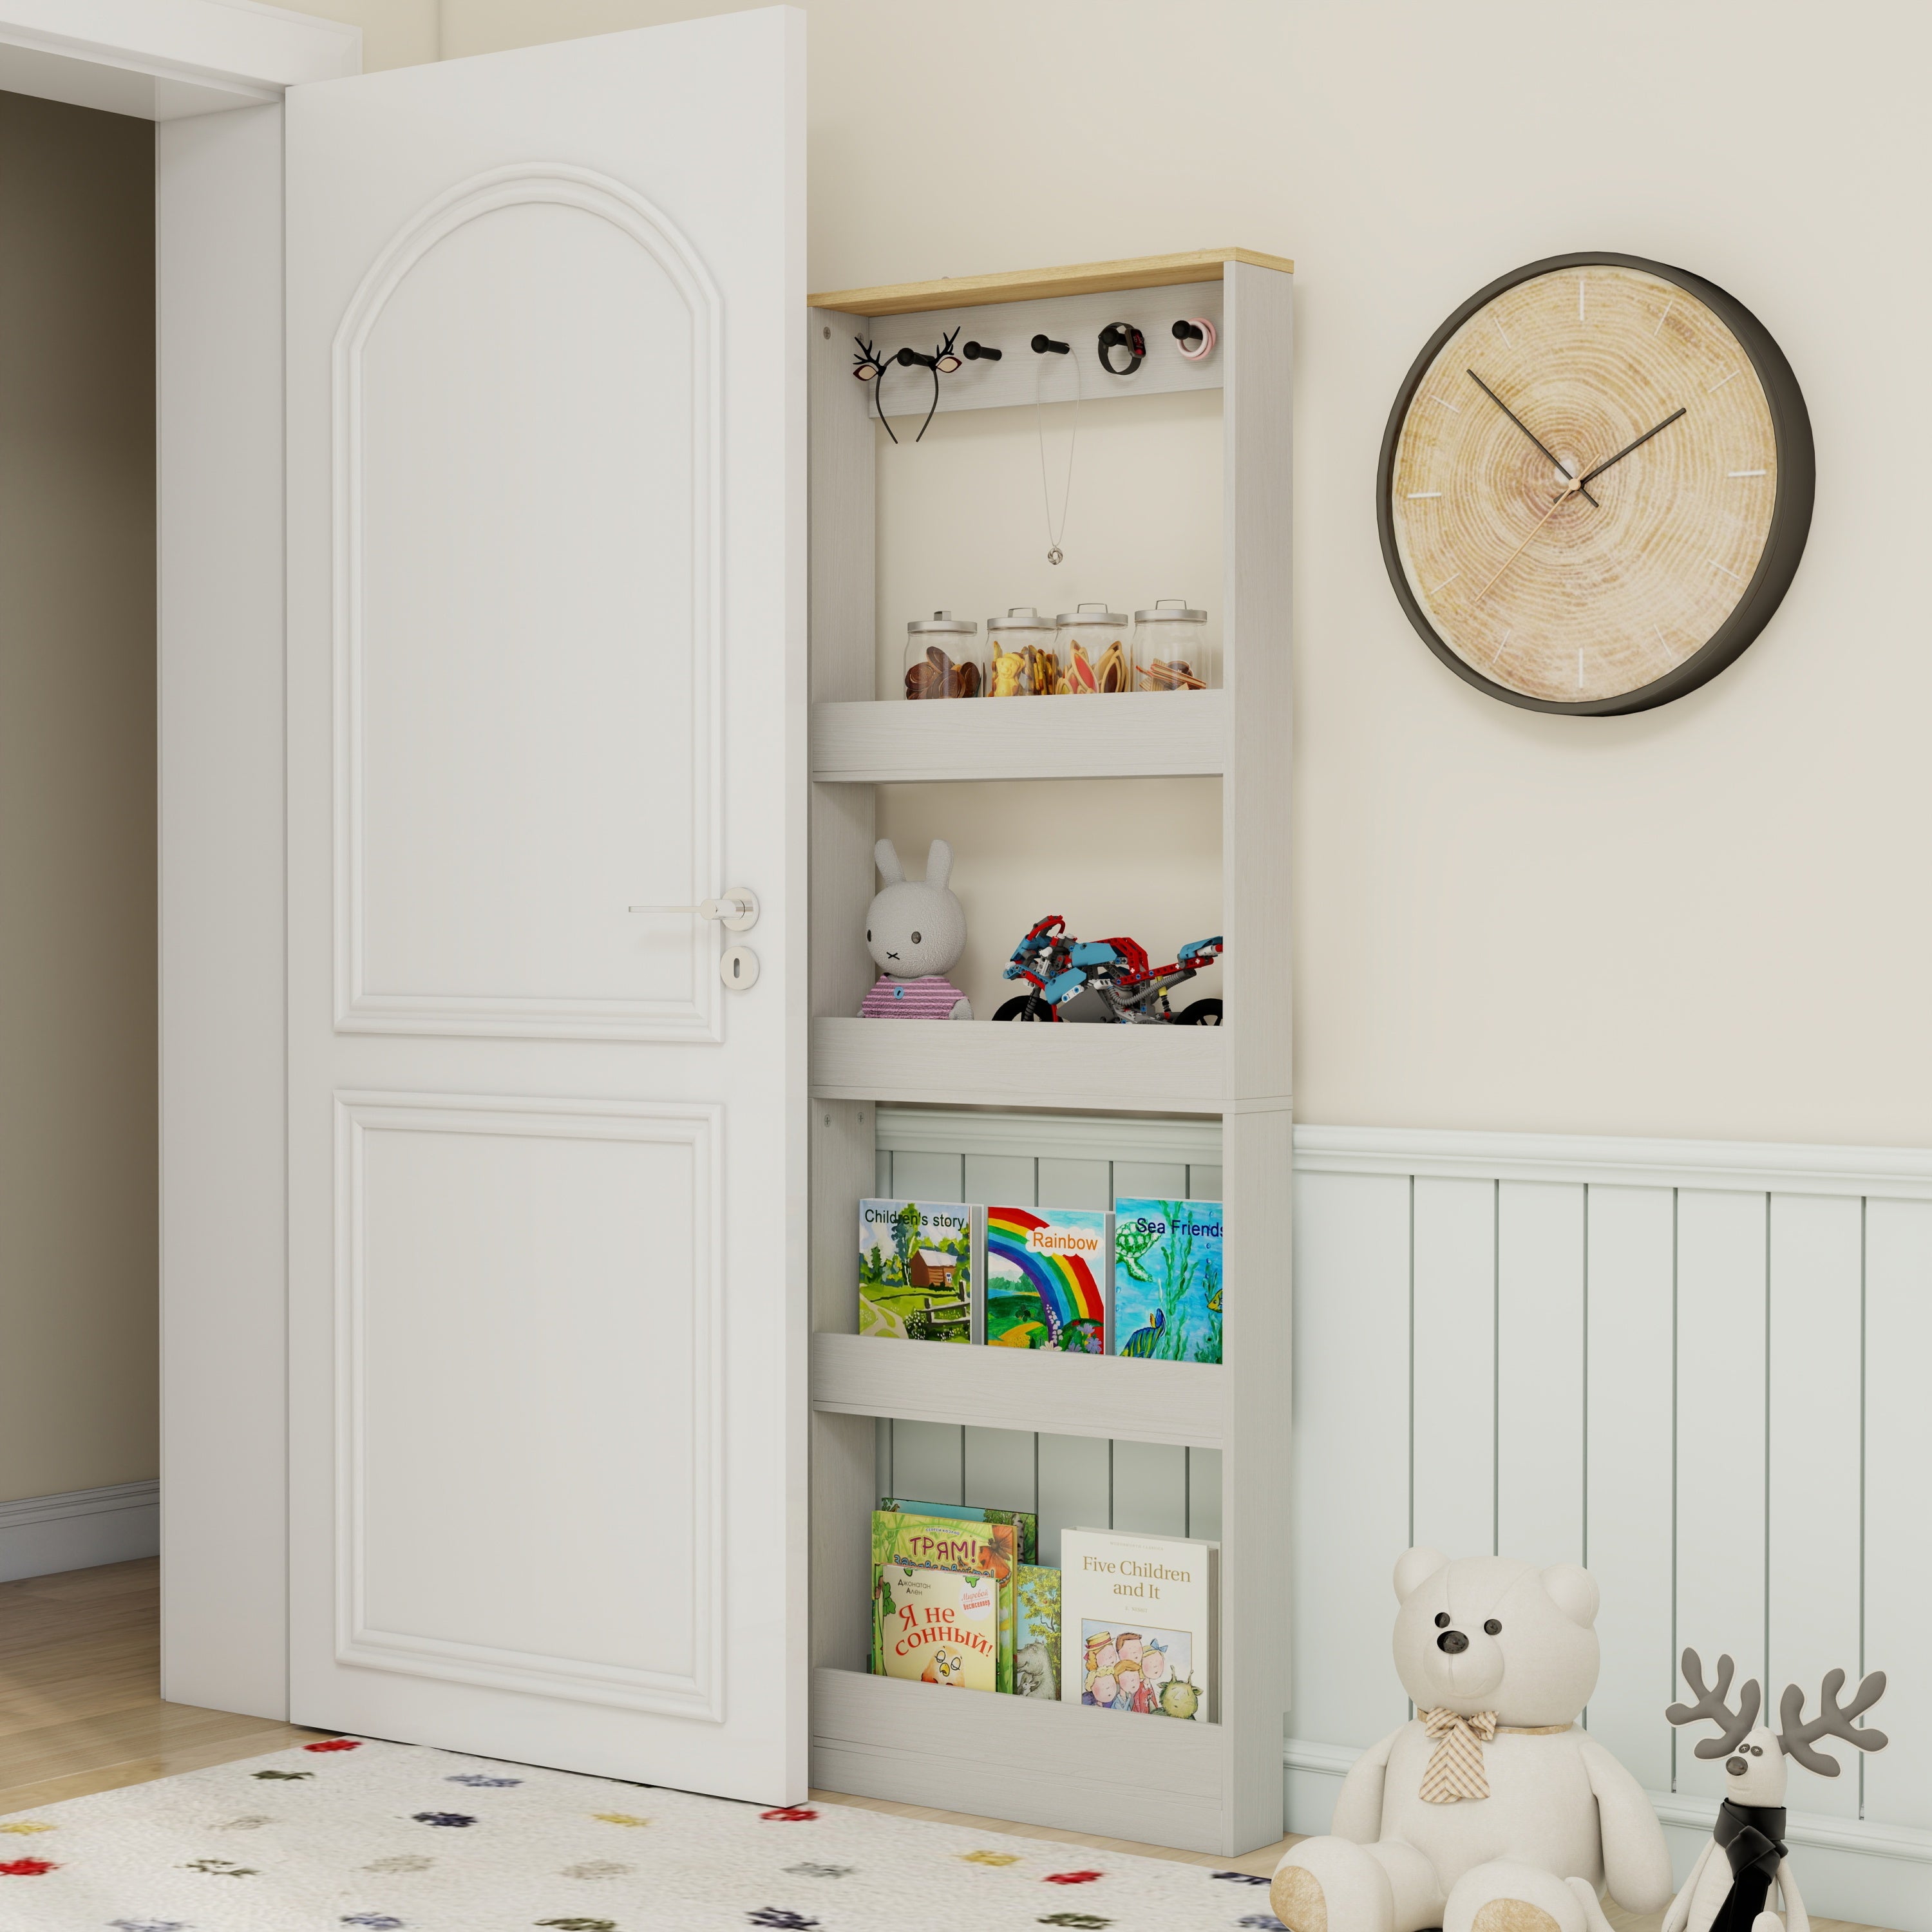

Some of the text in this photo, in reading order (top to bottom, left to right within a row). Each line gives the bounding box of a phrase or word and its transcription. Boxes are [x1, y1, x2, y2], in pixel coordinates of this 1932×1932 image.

[865, 1209, 965, 1231] Children's story
[1137, 1217, 1166, 1234] Sea
[1033, 1231, 1099, 1251] Rainbow
[909, 1536, 976, 1564] ТРЯМ!
[1083, 1555, 1191, 1582] Five Children
[898, 1579, 931, 1589] Джонатан
[1113, 1582, 1160, 1599] and It
[898, 1604, 955, 1632] Я не
